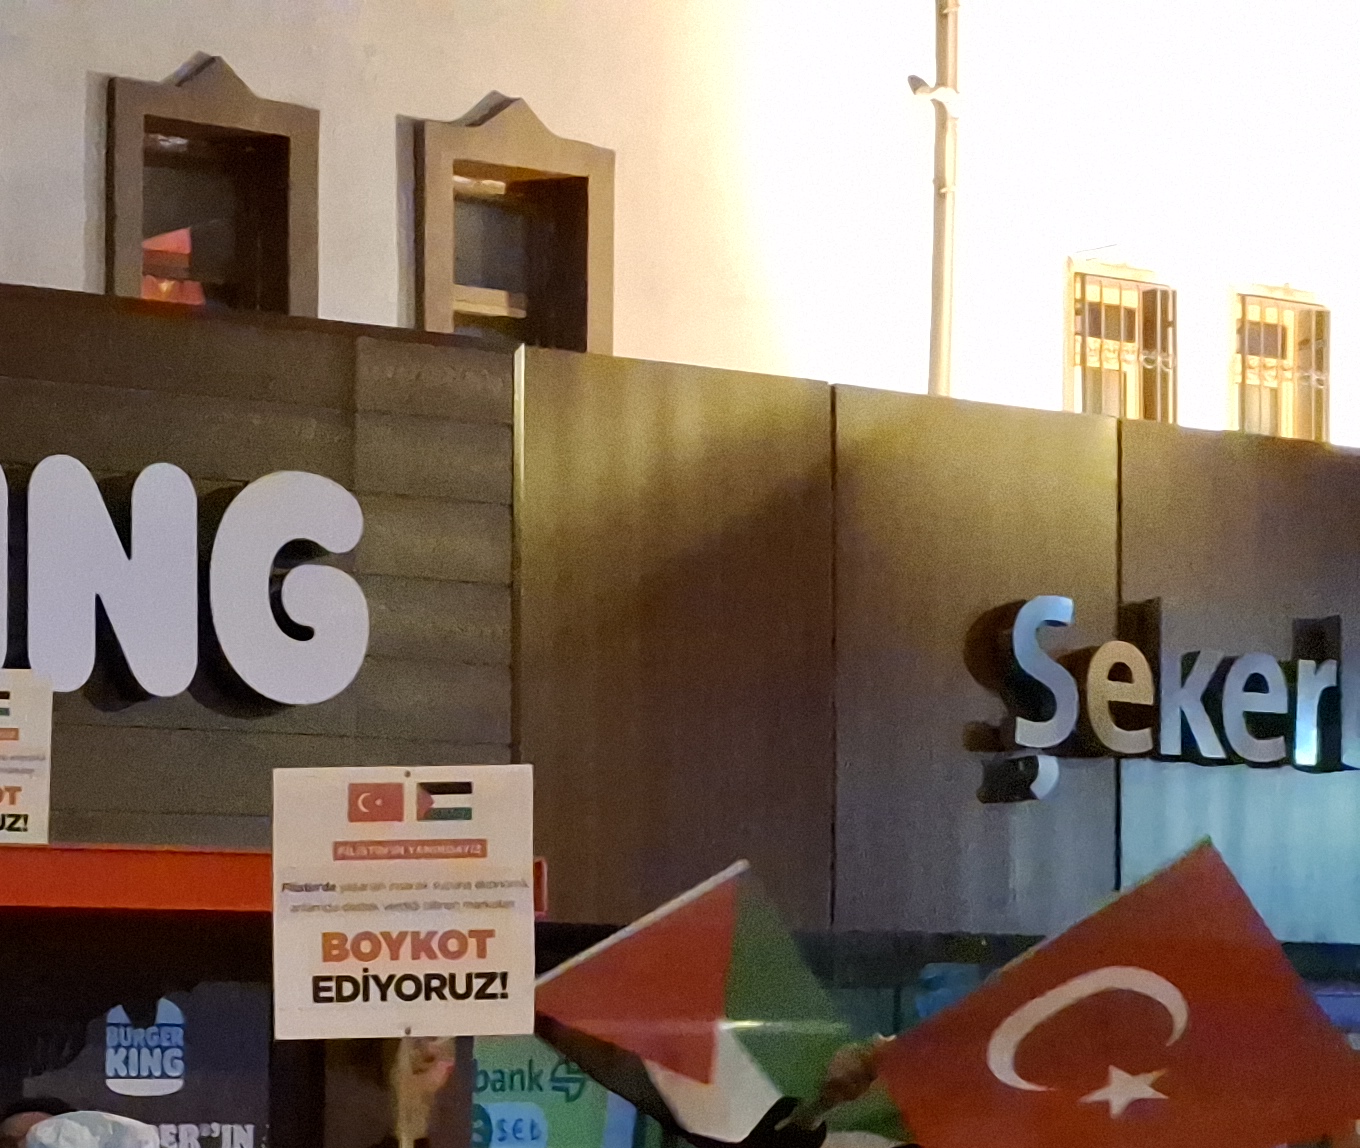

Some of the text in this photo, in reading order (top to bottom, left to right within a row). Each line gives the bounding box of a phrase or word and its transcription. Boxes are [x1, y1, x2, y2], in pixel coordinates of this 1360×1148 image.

[321, 929, 495, 962] BOYKOT
[312, 967, 509, 1003] EDİYORUZ!
[106, 1026, 184, 1047] BURGER
[105, 1048, 184, 1077] KING
